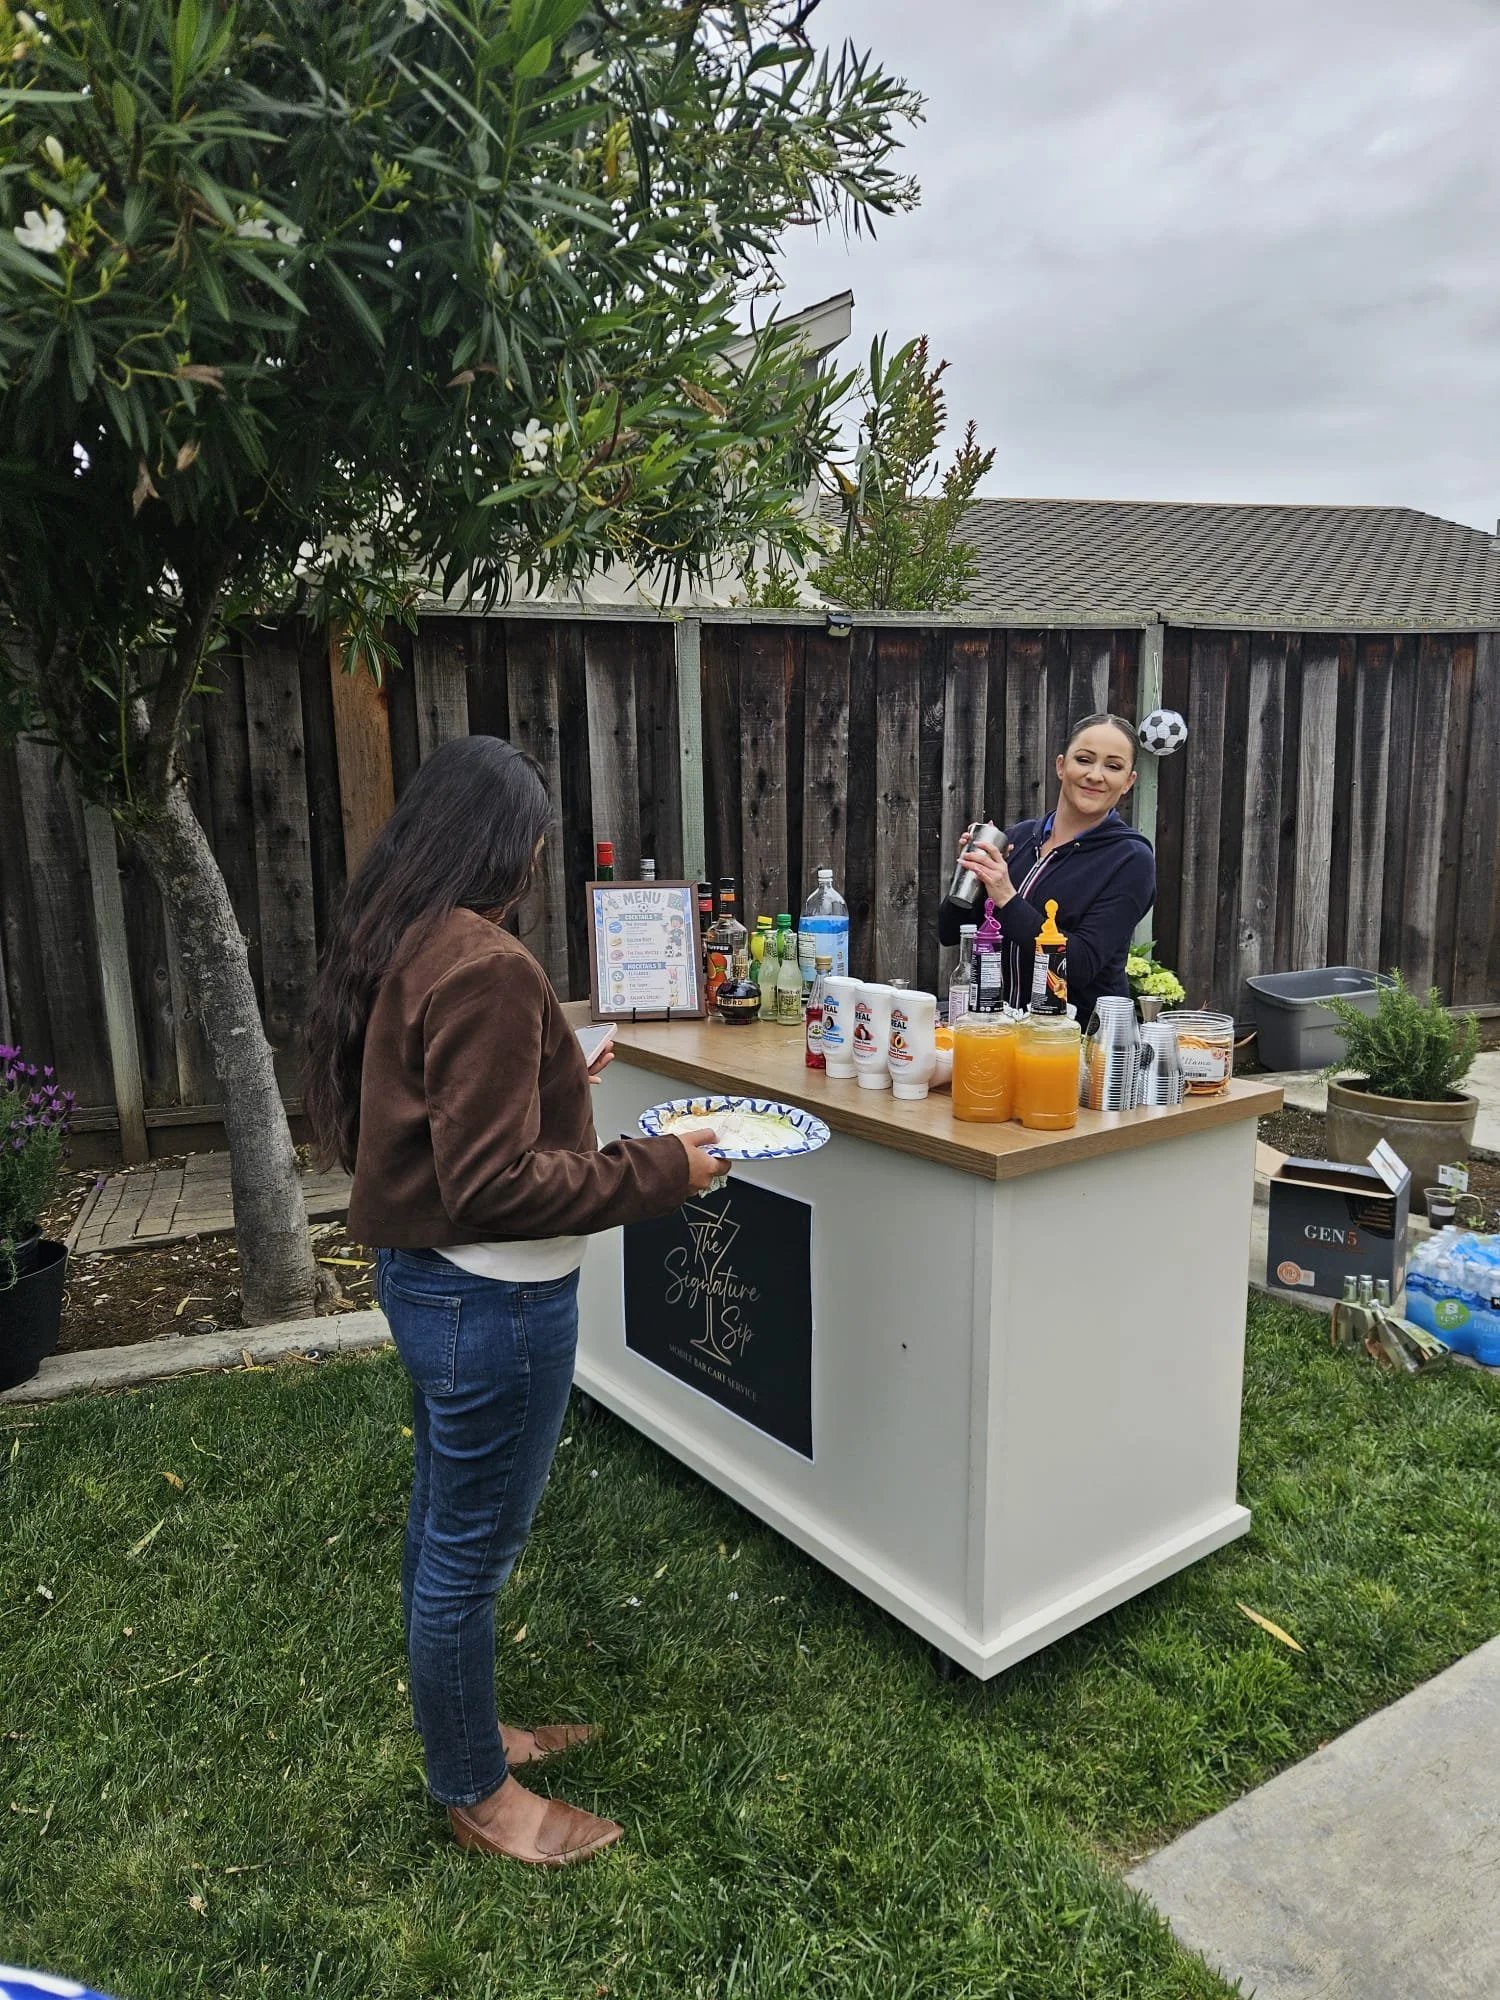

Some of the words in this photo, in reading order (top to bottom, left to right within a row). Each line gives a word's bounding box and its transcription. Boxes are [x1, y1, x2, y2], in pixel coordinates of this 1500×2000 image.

[623, 891, 661, 906] MENU
[824, 1004, 838, 1014] REAL
[855, 1012, 871, 1022] REAL
[891, 1020, 907, 1029] REAL
[688, 1221, 723, 1264] The
[664, 1247, 760, 1309] Signature
[721, 1306, 755, 1357] Sip
[669, 1344, 693, 1363] MOBILE
[693, 1357, 707, 1372] BAR
[707, 1366, 726, 1383] CART
[727, 1377, 757, 1402] SERVICE
